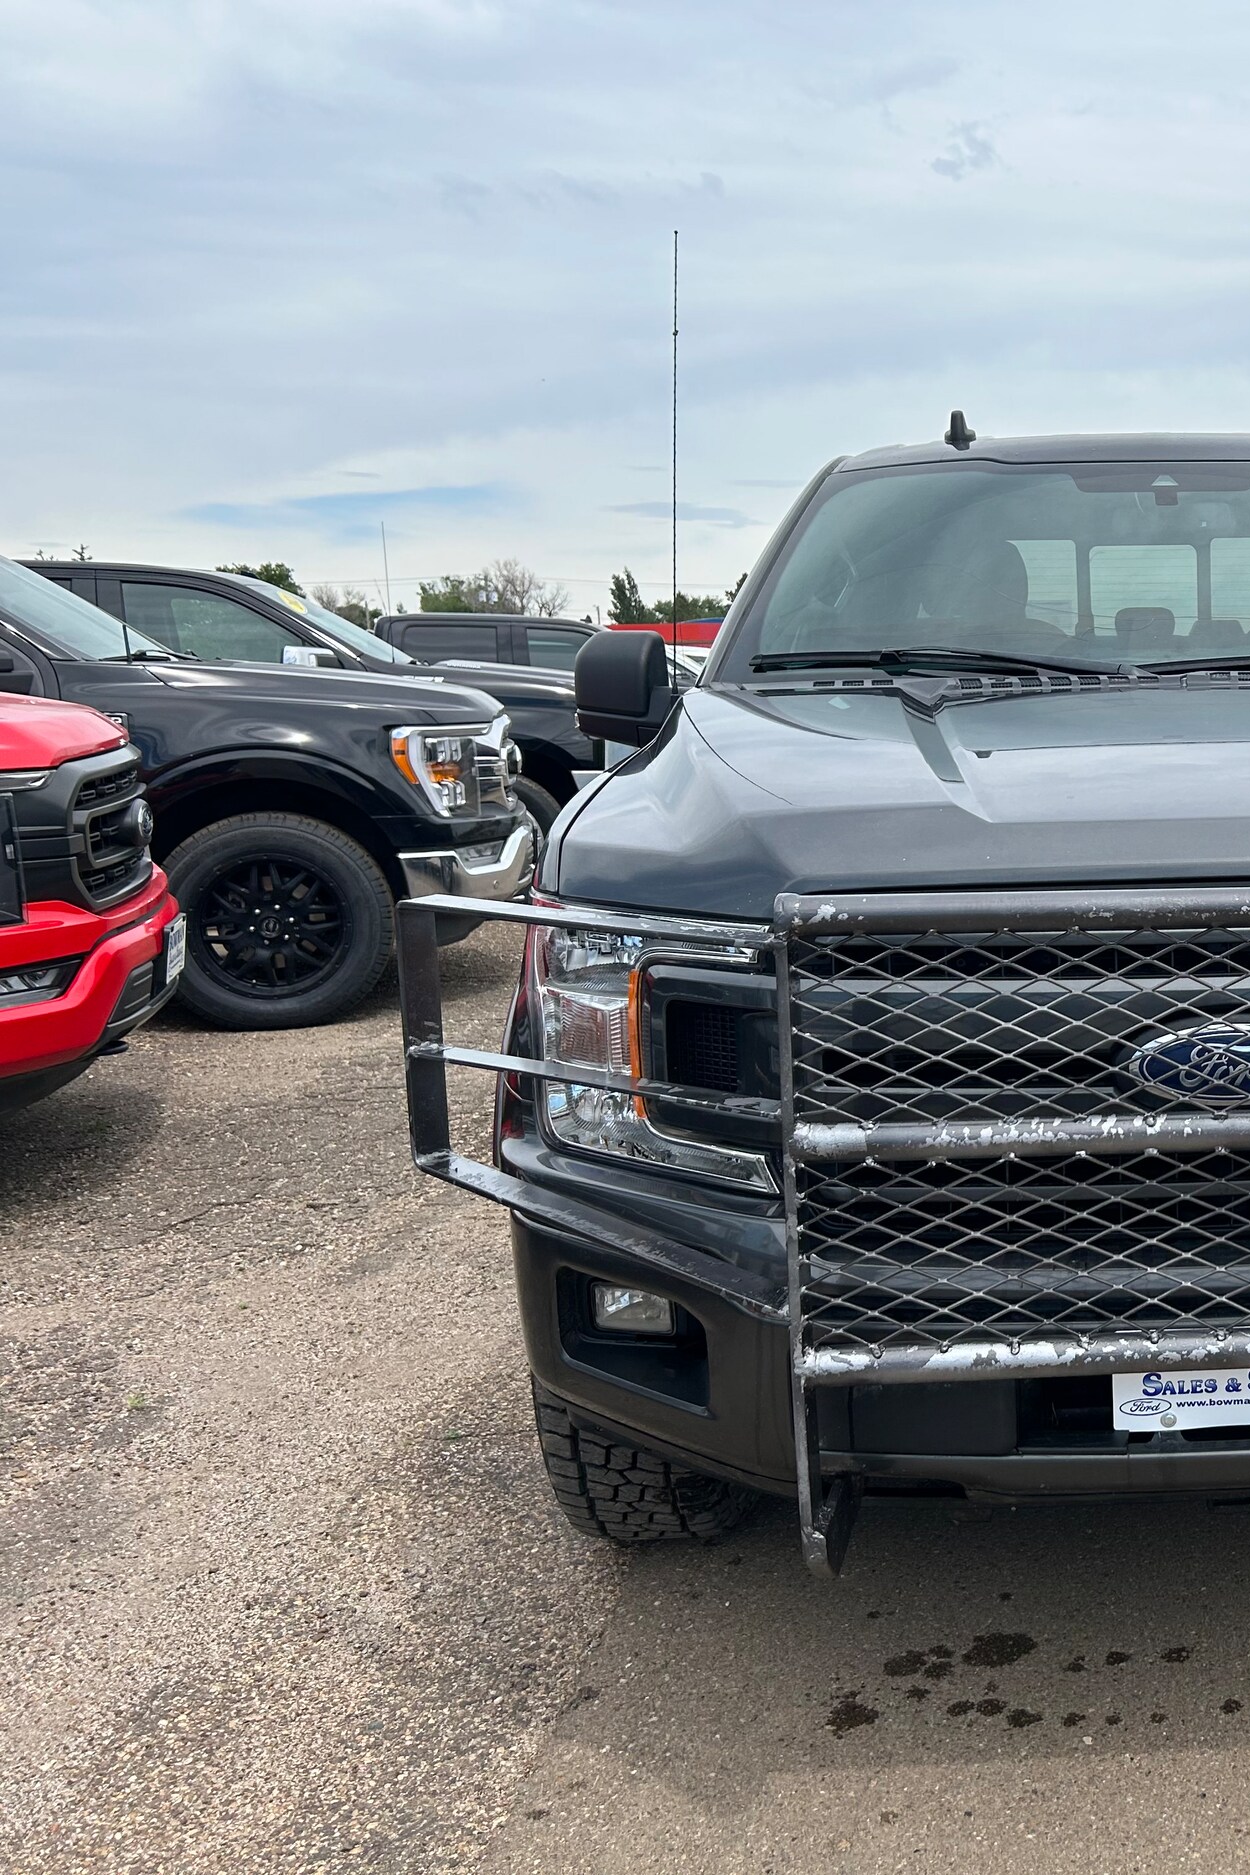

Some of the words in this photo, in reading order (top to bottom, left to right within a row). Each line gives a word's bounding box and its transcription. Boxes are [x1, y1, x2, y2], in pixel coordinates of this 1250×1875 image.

[1142, 1372, 1218, 1397] SALES
[1225, 1378, 1242, 1393] &
[1129, 1400, 1161, 1413] Ford
